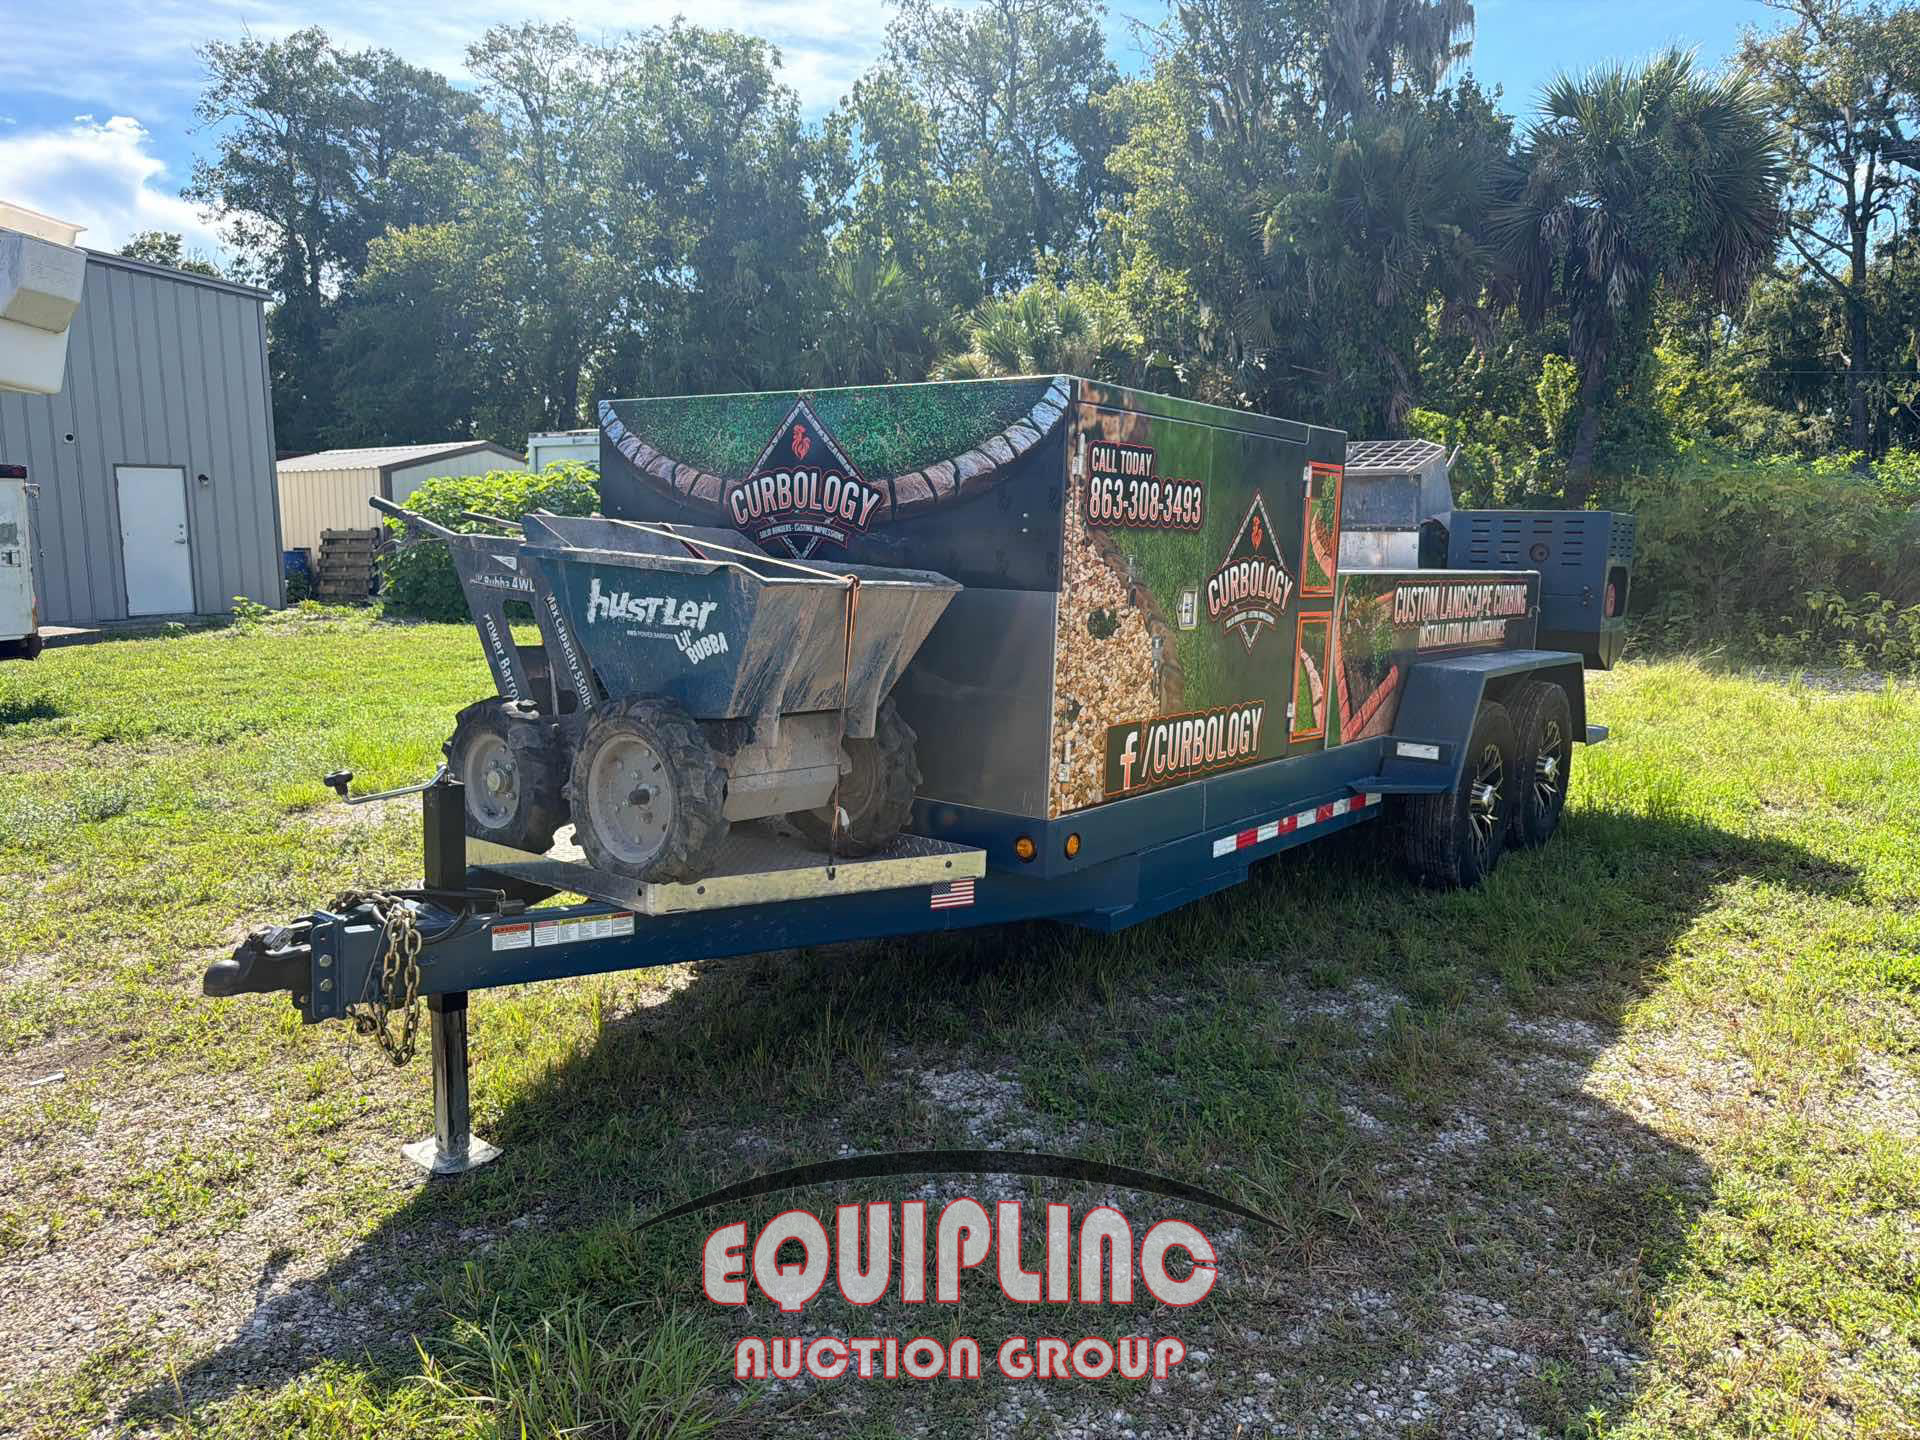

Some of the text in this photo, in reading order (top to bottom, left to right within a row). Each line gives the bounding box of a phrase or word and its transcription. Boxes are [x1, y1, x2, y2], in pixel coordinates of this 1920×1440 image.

[1092, 447, 1152, 476] CALL TODAY
[730, 471, 880, 526] CURBOLOGY
[1089, 477, 1202, 524] 863-308-3493
[1207, 560, 1294, 616] CURBOLOGY
[1394, 583, 1528, 624] CUSTOM LANDSCAPE CURBING
[555, 618, 579, 671] Capacity
[685, 631, 729, 665] BUBBA
